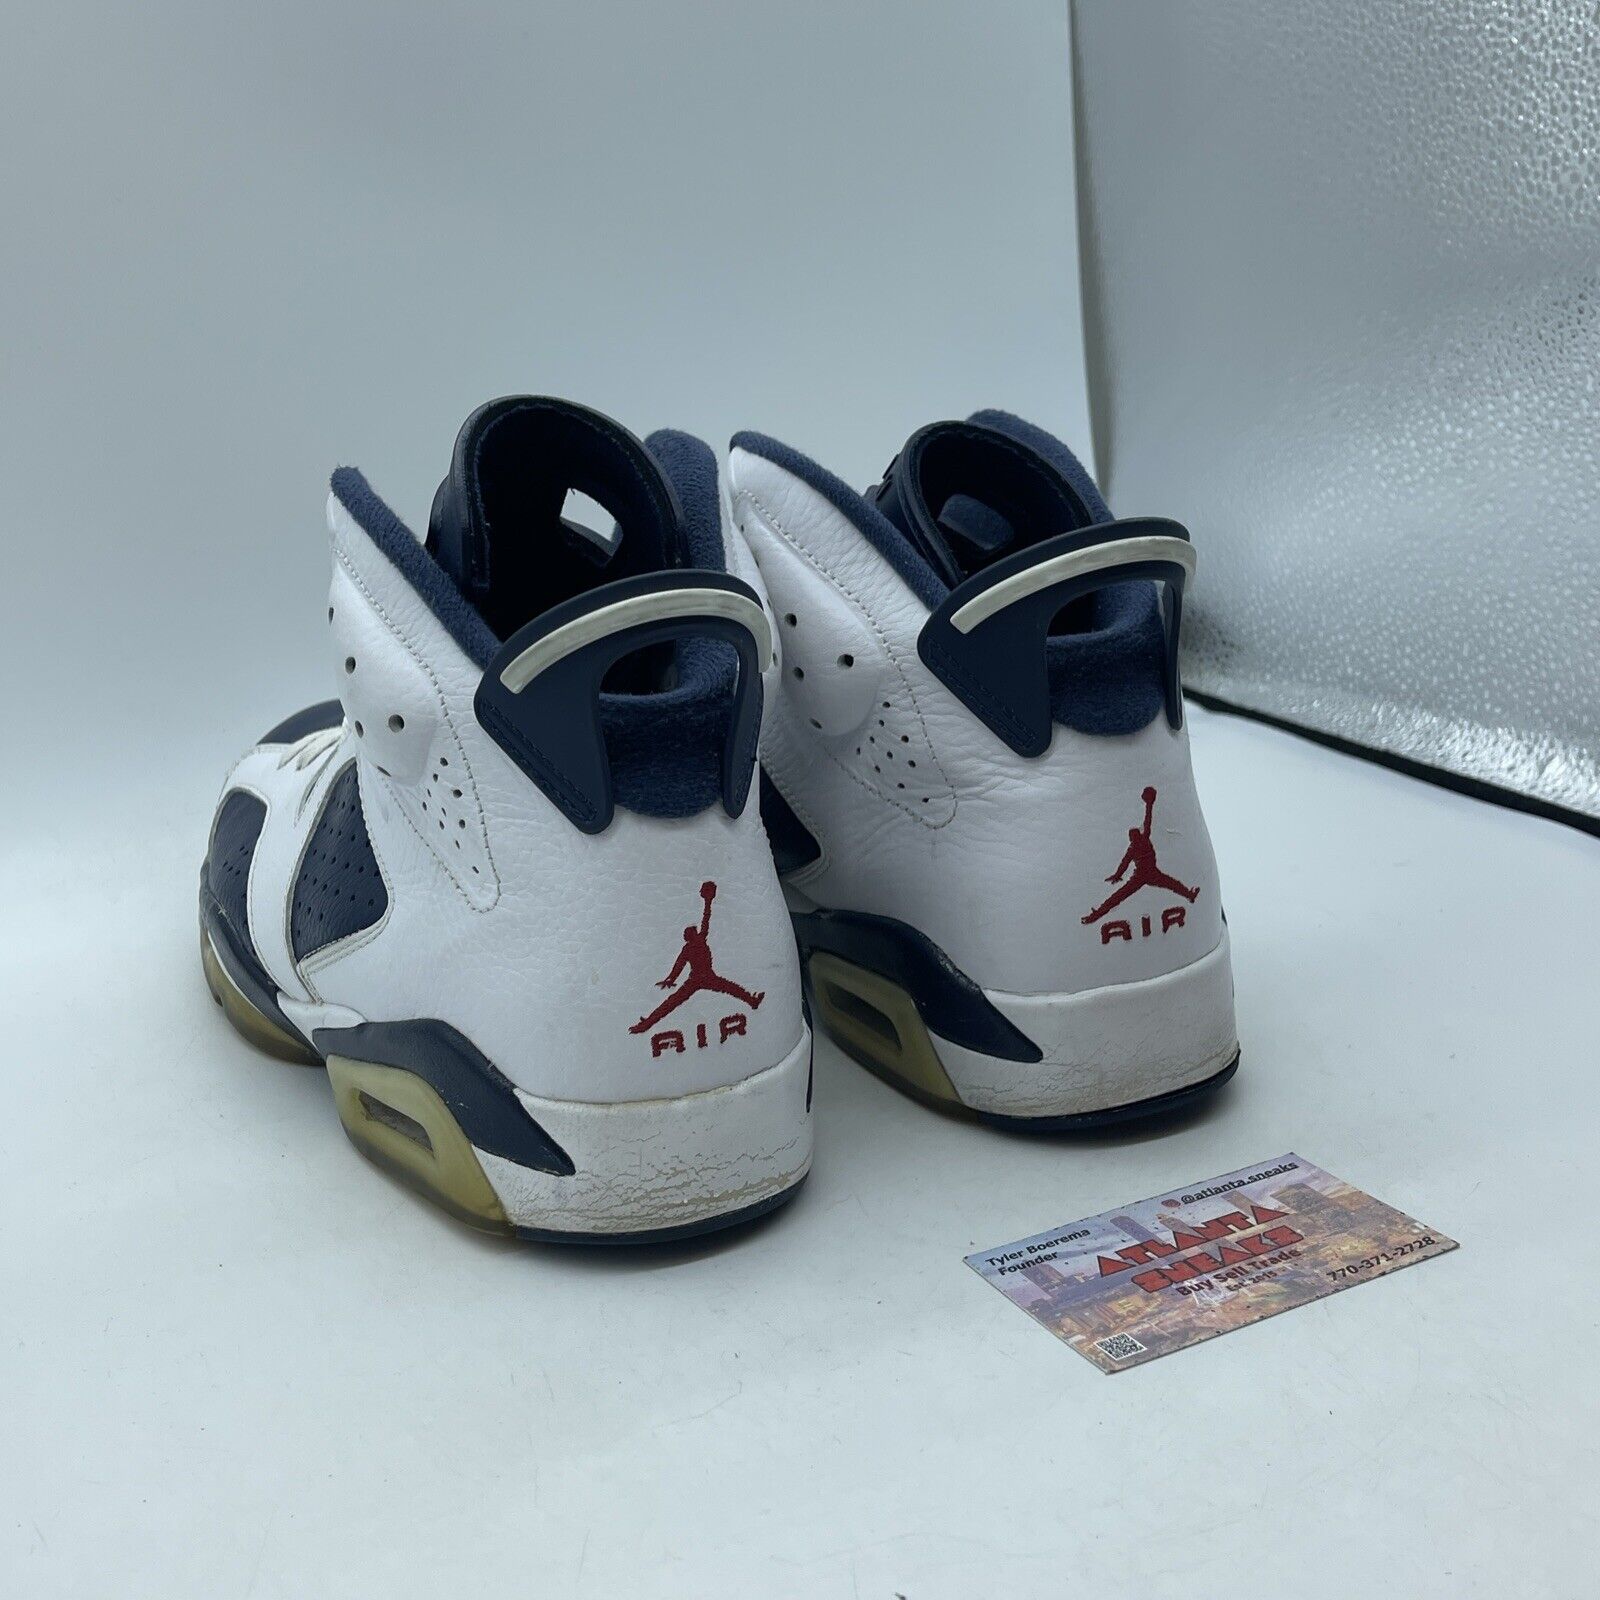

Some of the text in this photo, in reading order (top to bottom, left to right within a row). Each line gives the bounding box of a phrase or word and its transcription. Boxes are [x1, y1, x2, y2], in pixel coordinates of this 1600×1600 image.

[1101, 906, 1186, 944] AIR
[651, 1013, 747, 1058] AIR
[1181, 1162, 1299, 1204] @atlanta.sneaks
[985, 1229, 1091, 1266] Tyler Boerema
[998, 1251, 1058, 1276] Founder
[1097, 1205, 1289, 1278] ATLANTA
[1131, 1225, 1304, 1293] SNEAKS
[1326, 1236, 1436, 1281] 770-371-2728
[1176, 1249, 1302, 1296] Buy Sell Trade
